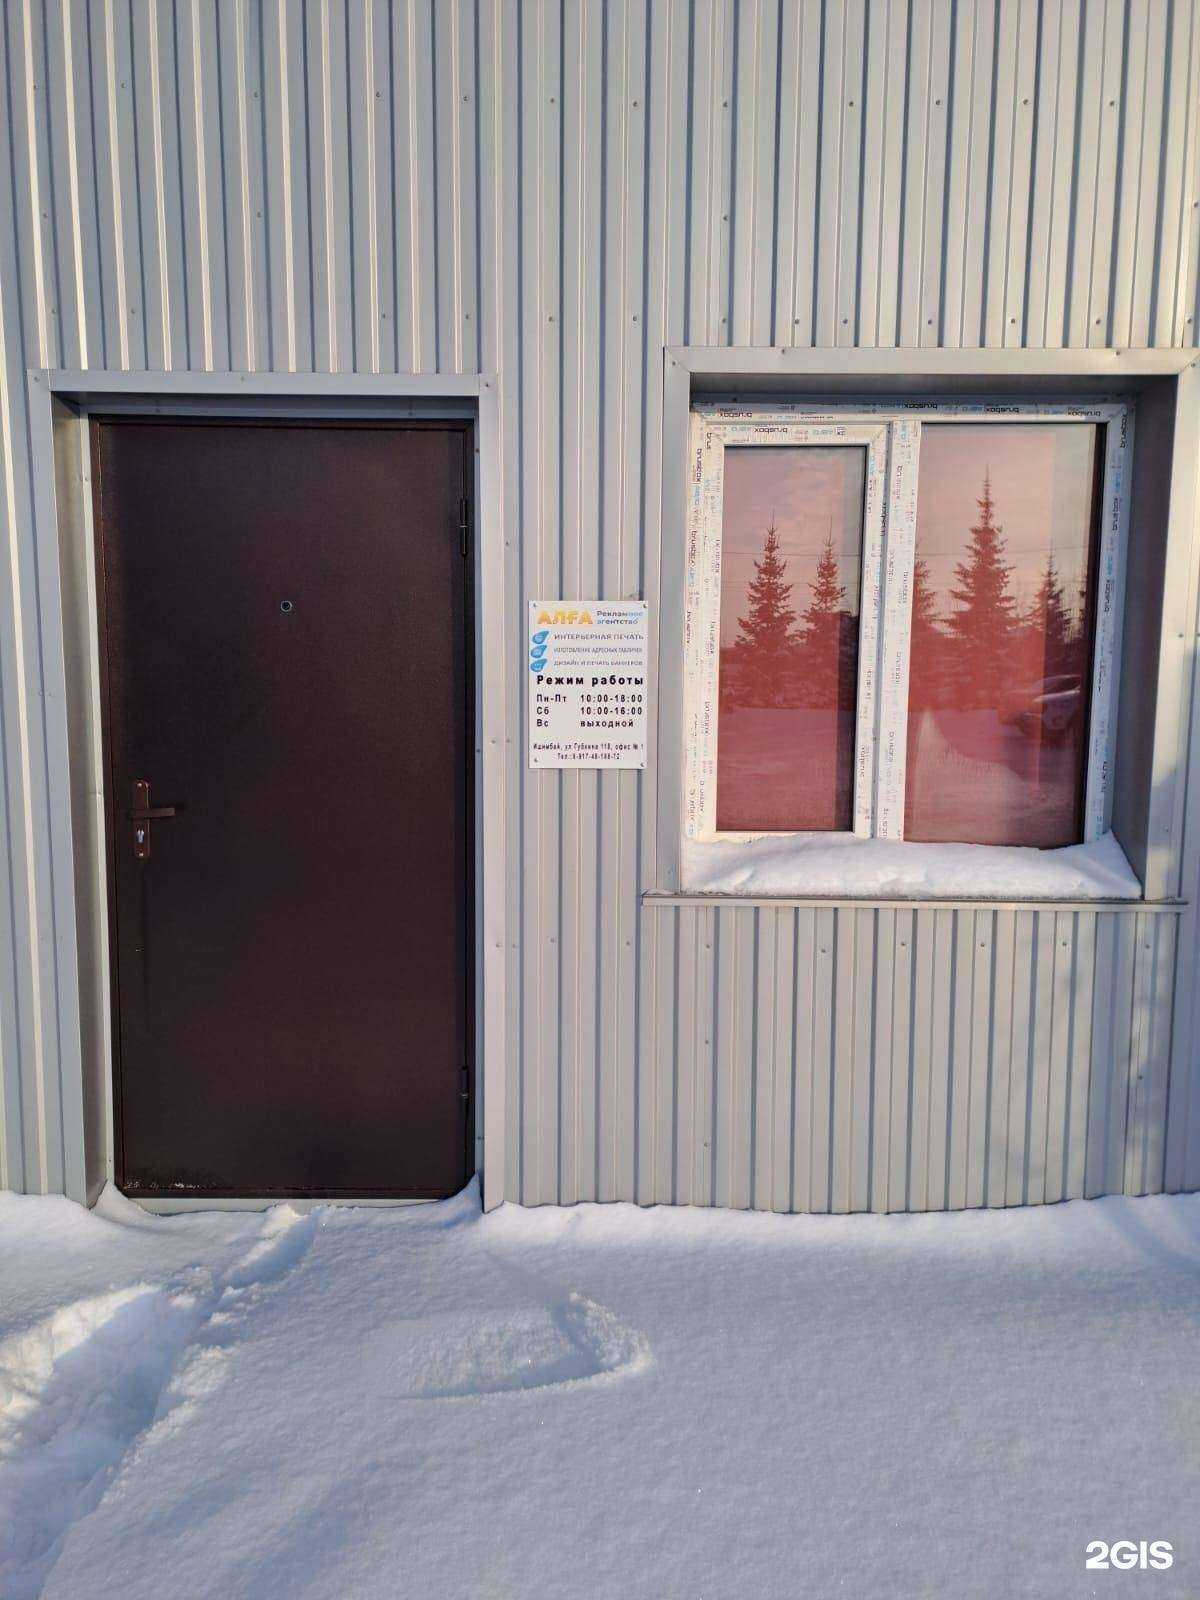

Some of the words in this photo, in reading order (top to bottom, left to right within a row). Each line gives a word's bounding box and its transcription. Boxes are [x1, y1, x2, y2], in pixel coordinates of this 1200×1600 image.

[537, 675, 584, 685] Режим
[592, 675, 643, 687] работы
[536, 694, 567, 702] Пн-Пт
[580, 694, 643, 702] 10:00-18:00
[536, 706, 549, 715] Сб
[580, 706, 643, 715] 10:00-16:00
[536, 719, 549, 727] Вс
[580, 719, 634, 728] выходной
